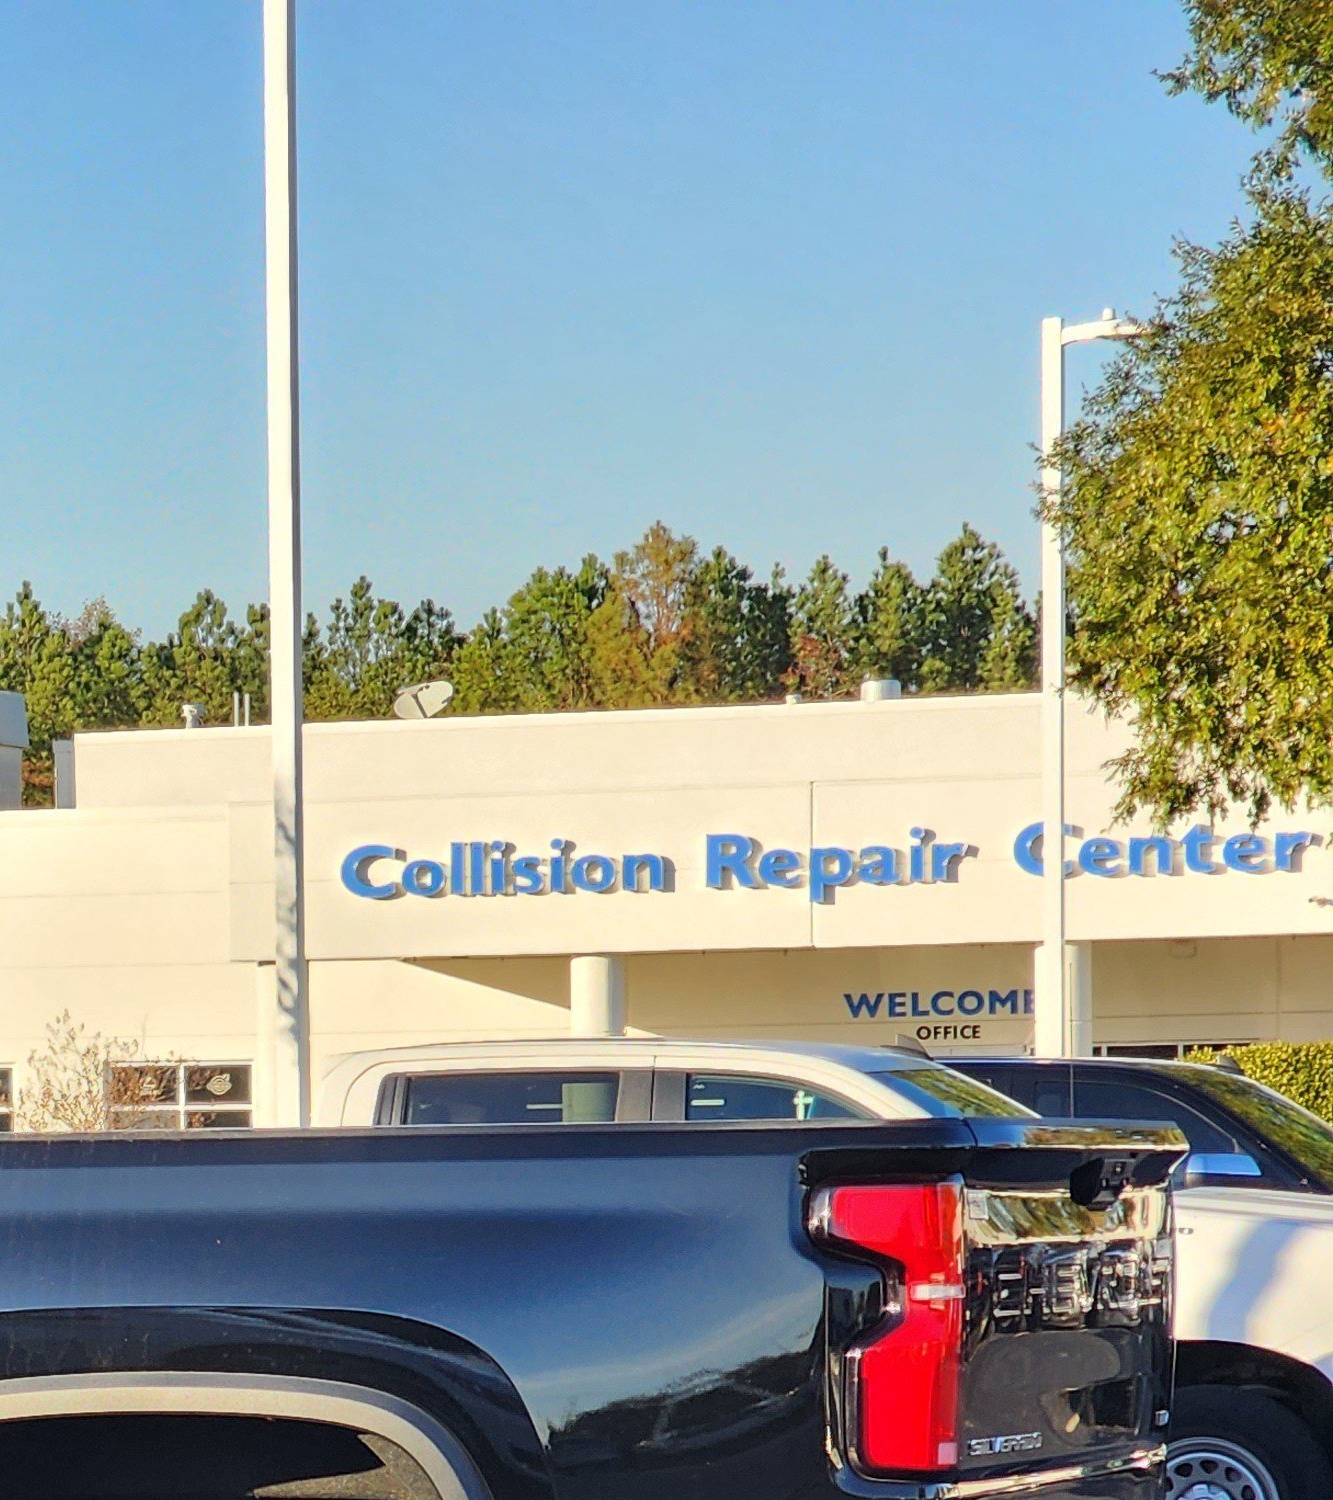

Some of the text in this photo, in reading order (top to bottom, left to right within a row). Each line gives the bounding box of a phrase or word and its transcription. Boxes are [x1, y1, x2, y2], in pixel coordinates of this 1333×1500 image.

[339, 820, 1315, 904] Collision Repair Center
[916, 1025, 981, 1040] OFFICE
